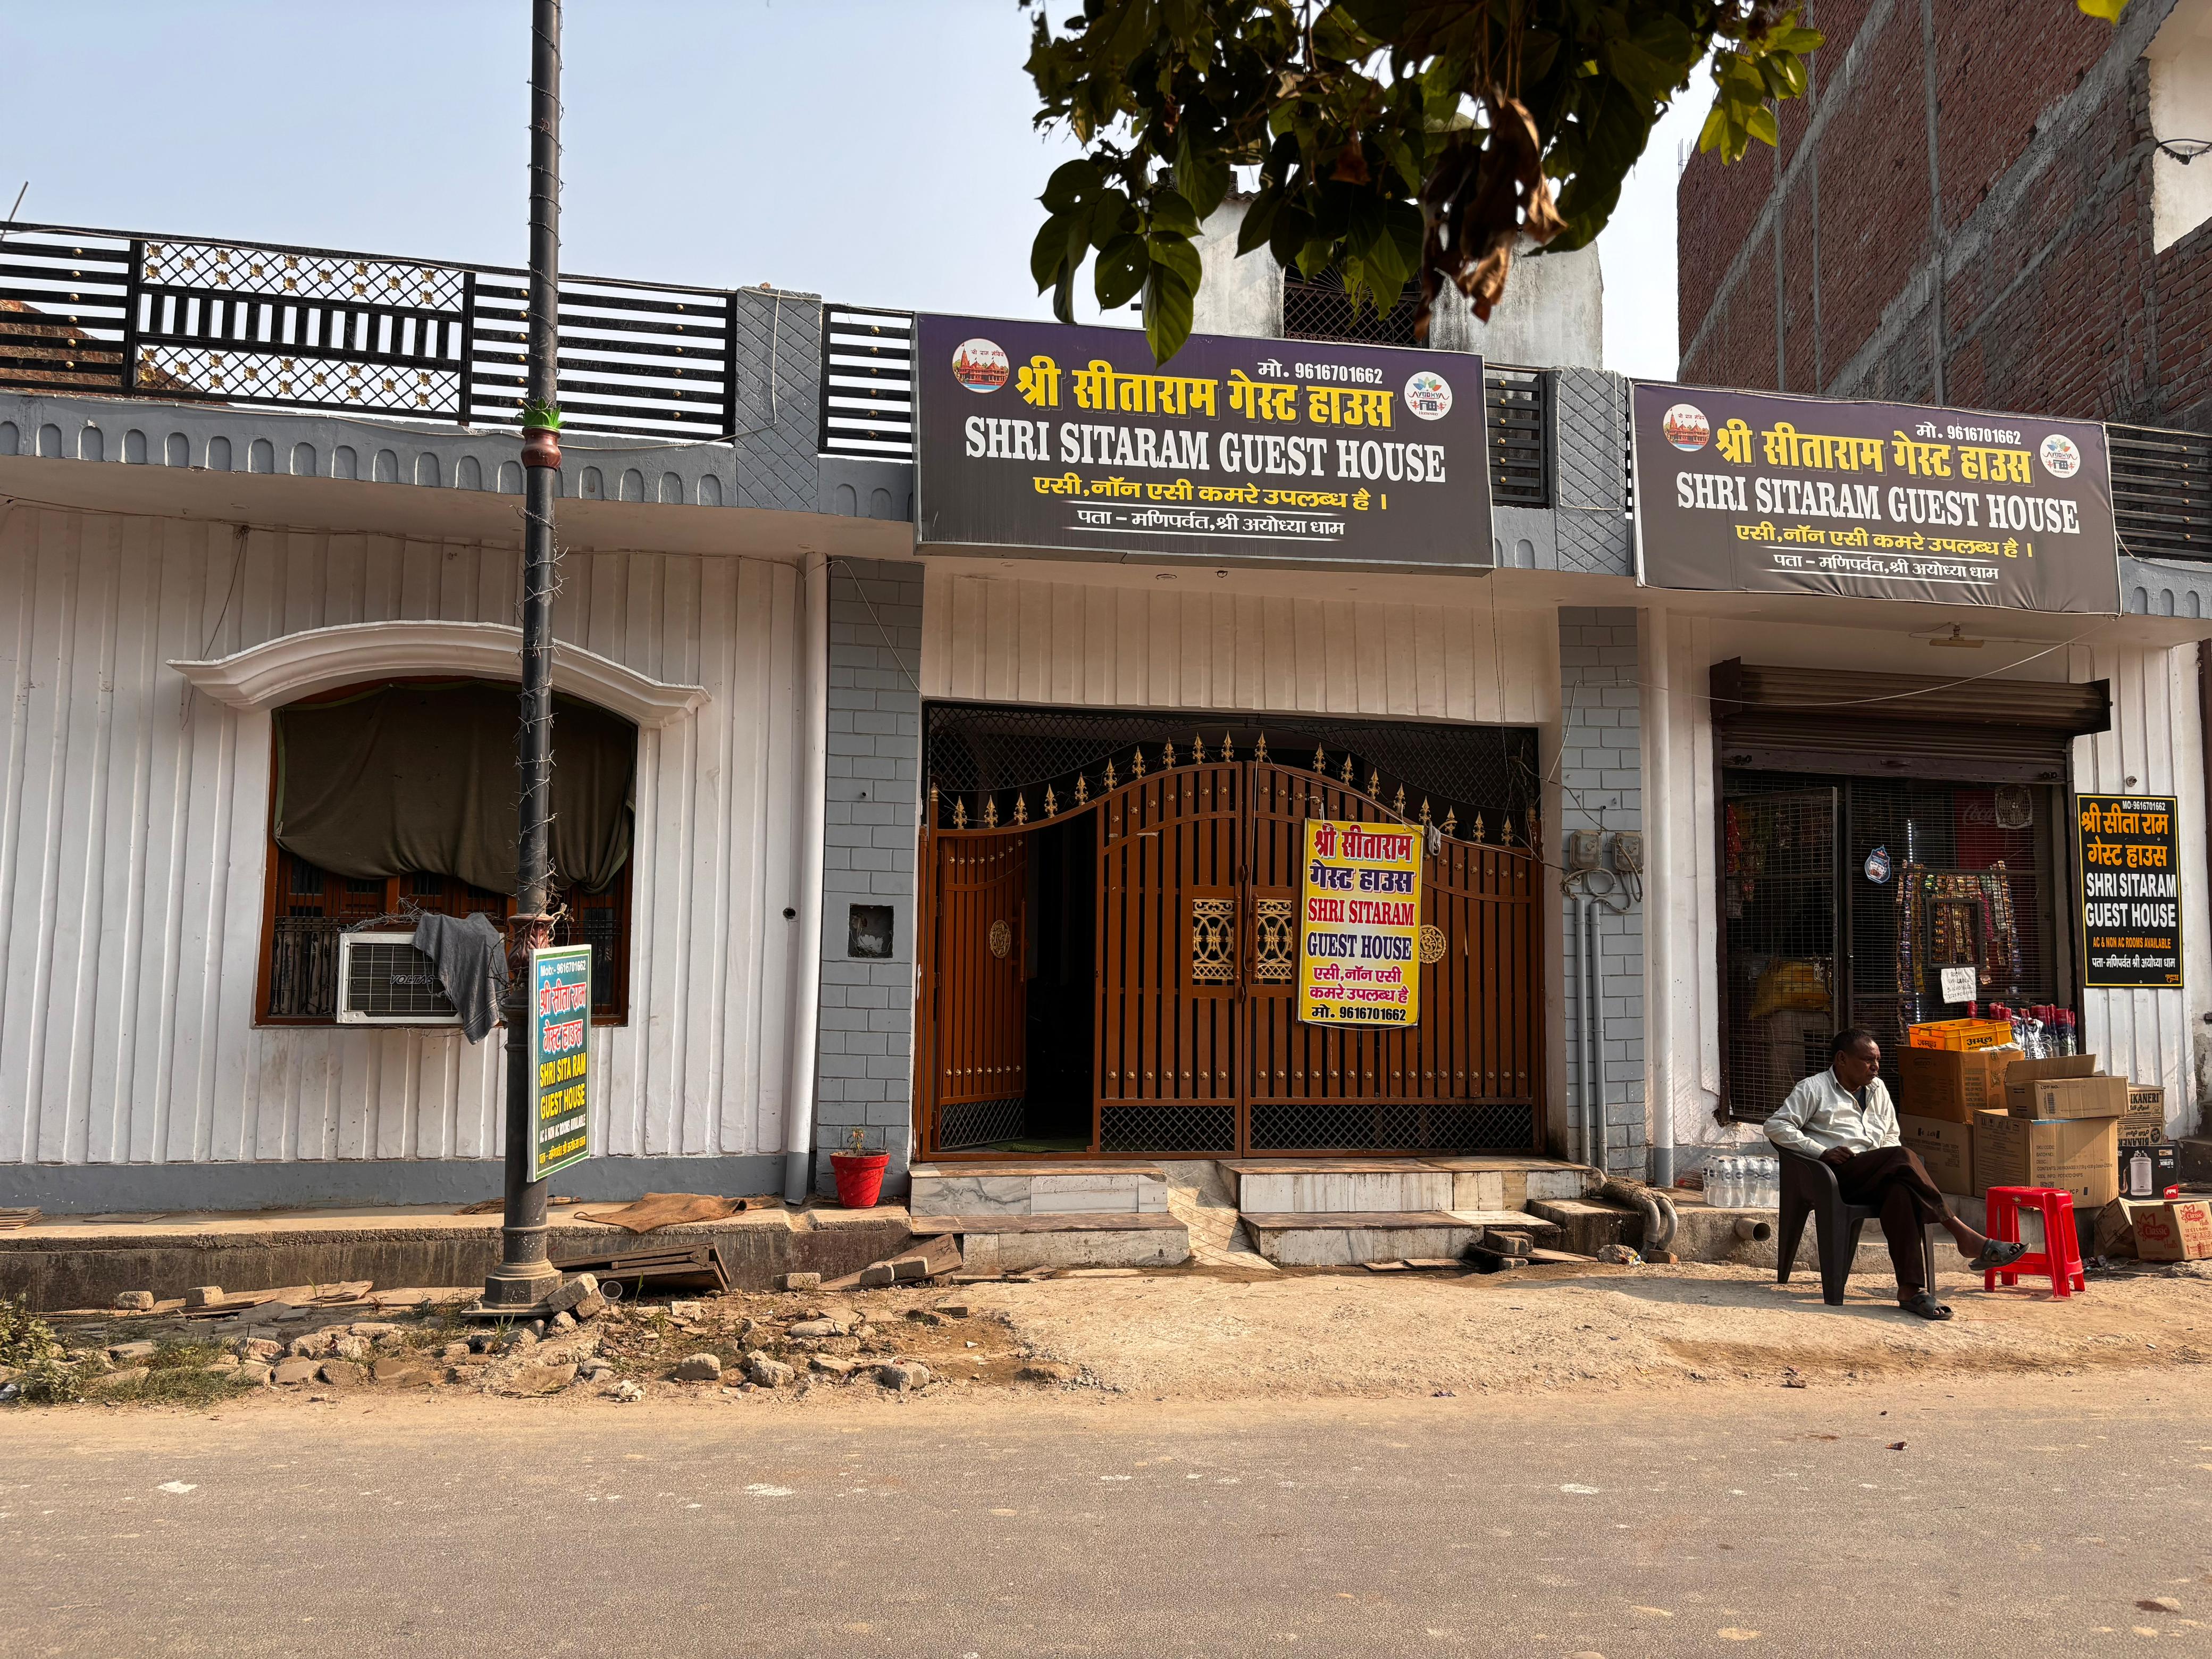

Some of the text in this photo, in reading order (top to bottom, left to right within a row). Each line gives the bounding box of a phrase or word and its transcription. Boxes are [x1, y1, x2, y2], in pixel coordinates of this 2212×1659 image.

[1258, 359, 1382, 384] मो. 9616701662
[1016, 355, 1394, 428] श्री सीताराम गेस्ट हाउस
[1916, 422, 2021, 445] मो. 9616701662
[966, 416, 1446, 483] SHRI SITARAM GUEST HOUSE
[1715, 418, 2031, 484] श्री सीताराम गेस्ट हाउस
[1147, 478, 1194, 501] एसी
[1199, 482, 1260, 505] कमरे
[1262, 489, 1347, 508] उपलब्ध
[1352, 488, 1371, 510] है
[1677, 472, 2080, 534] SHRI SITARAM GUEST HOUSE
[1077, 510, 1112, 525] पता
[1243, 516, 1308, 533] अयोध्या
[1310, 521, 1345, 535] धाम
[1830, 527, 1869, 547] एसी
[1873, 532, 1925, 551] कमरे
[1929, 538, 2000, 555] उपलब्ध
[2004, 538, 2019, 558] है
[1773, 554, 1803, 568] पता
[1912, 561, 1967, 578] अयोध्या
[1970, 567, 1999, 580] धाम
[2081, 802, 2168, 835] श्री सीता राम
[1313, 822, 1413, 861] श्री सीताराम
[2087, 835, 2167, 868] गेस्ट हाउस
[1309, 859, 1415, 893] गेस्ट हाउस
[2087, 873, 2177, 898] SHRI SITARAM
[1308, 898, 1414, 926] SHRI SITARAM
[2085, 903, 2176, 927] GUEST HOUSE
[1308, 932, 1412, 960] GUEST HOUSE
[2093, 937, 2172, 949] AC & NON AC ROOMS AVAILABLE
[557, 960, 586, 975] 9616701662
[1376, 966, 1402, 983] एसी
[2141, 954, 2163, 968] अयोध्या
[2164, 958, 2175, 968] धाम
[390, 974, 435, 985] VOLTAS
[540, 980, 551, 1018] श्री
[1309, 983, 1410, 1004] कमरे उपलब्ध है
[1311, 1004, 1406, 1021] मो. 9616701662
[543, 1019, 583, 1054] गेस्ट हाउस
[540, 1052, 586, 1087] SHRI SITA RAM
[540, 1083, 585, 1120] GUEST HOUSE
[2130, 1093, 2159, 1104] IKANERI
[2118, 1137, 2149, 1146] BIKANER
[2144, 1226, 2167, 1236] Classic
